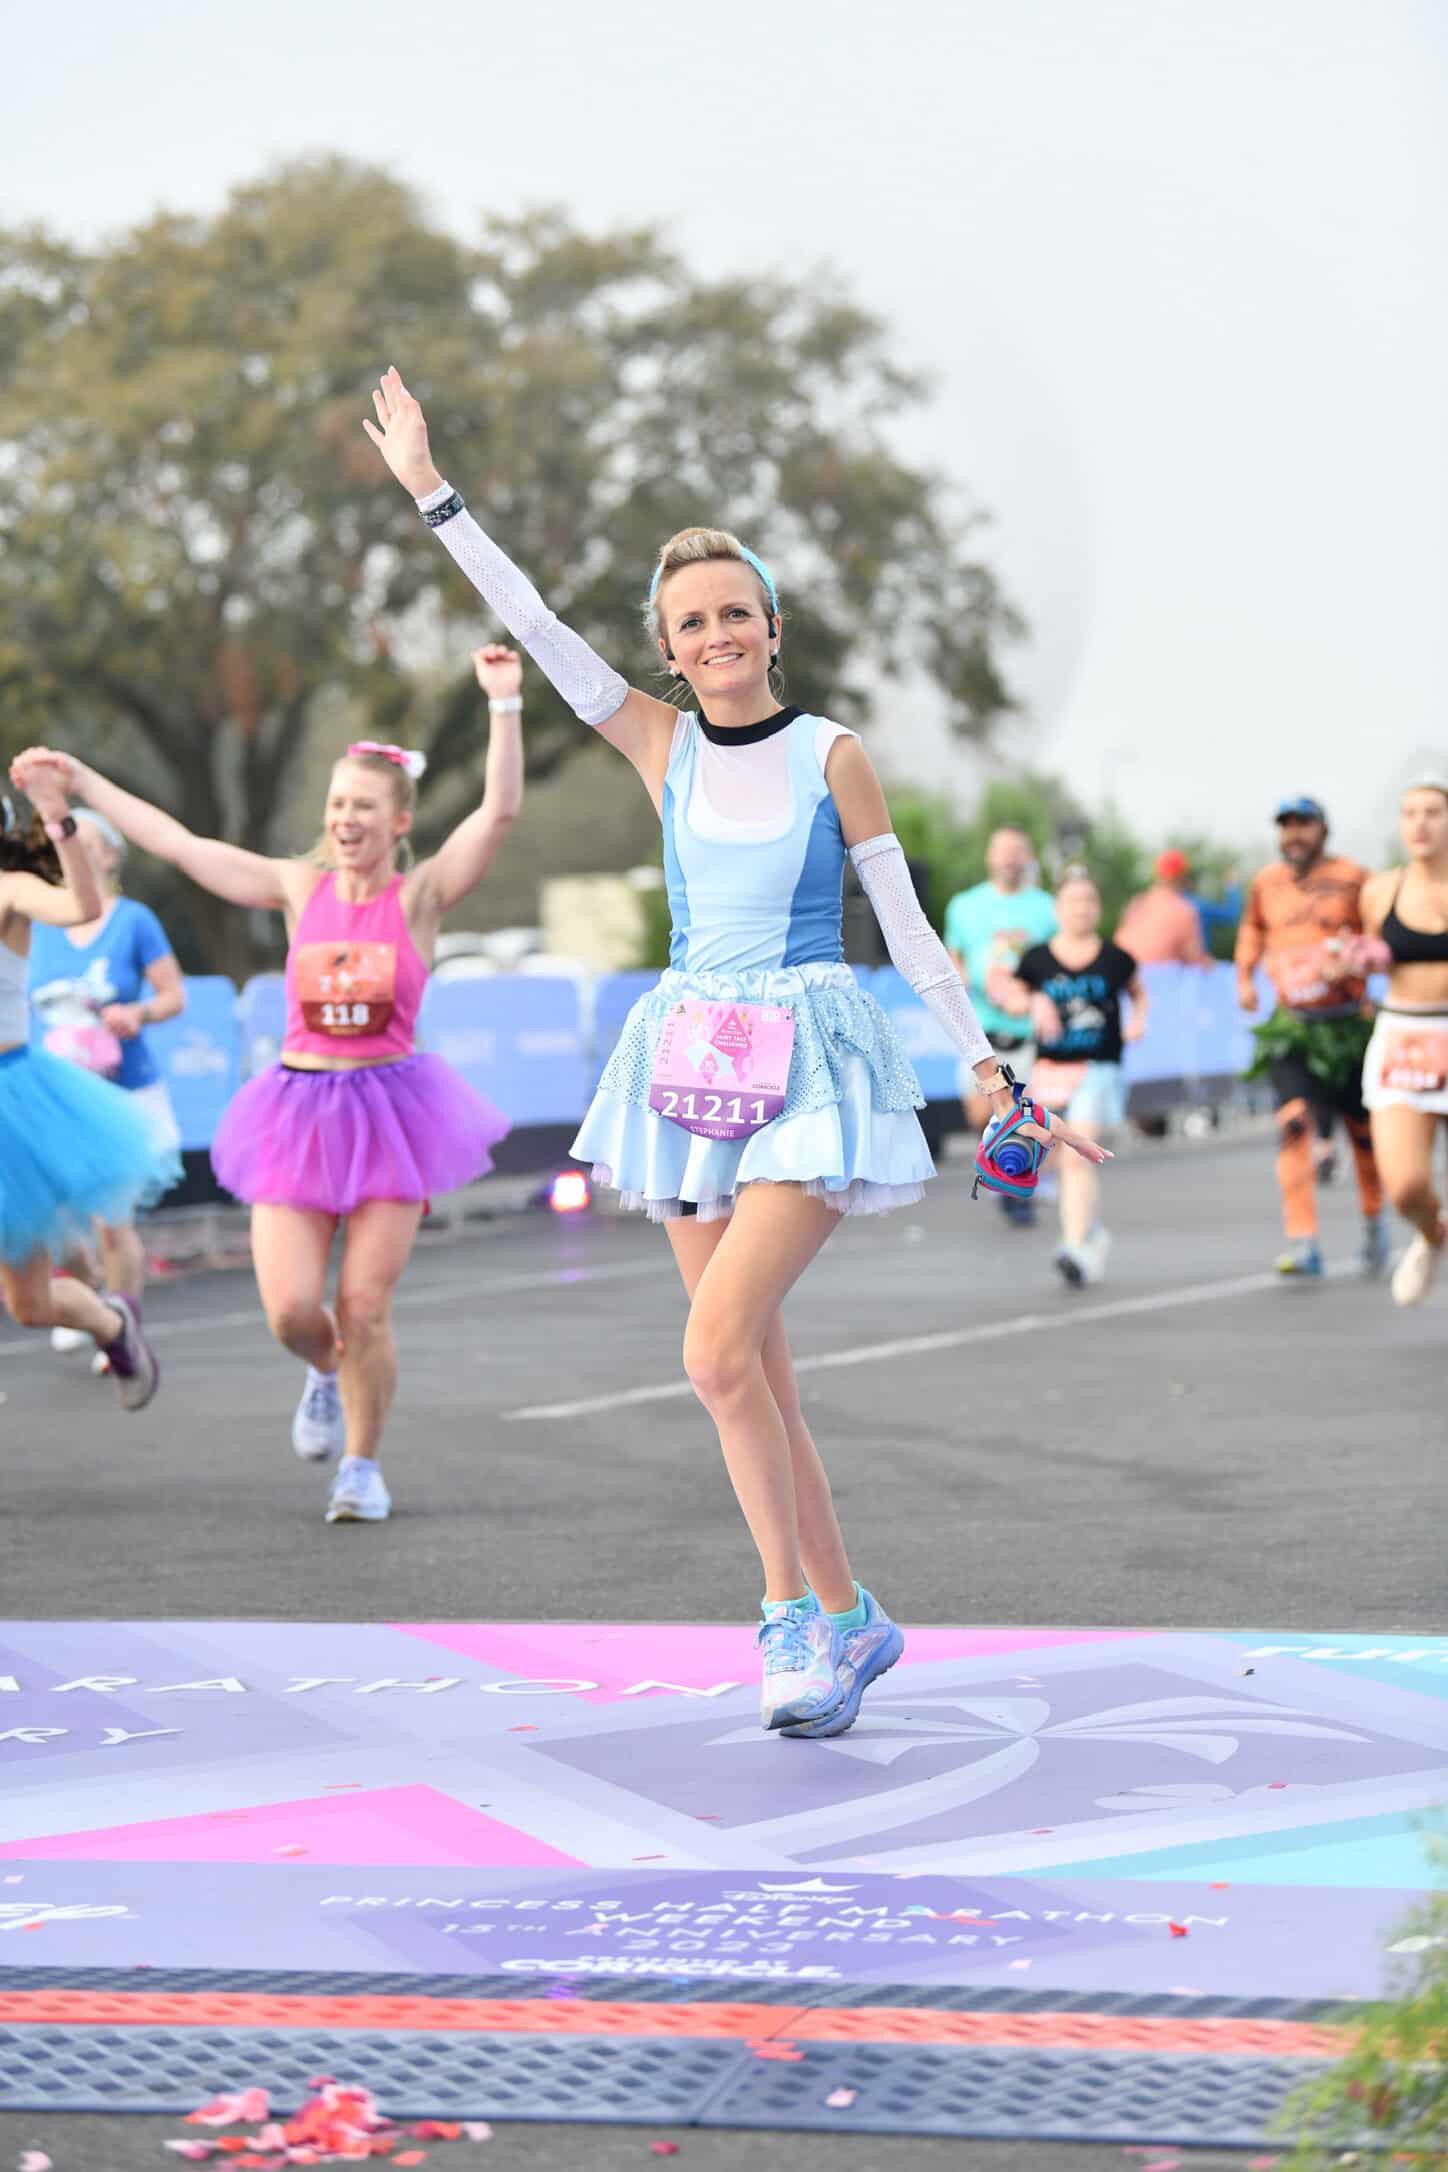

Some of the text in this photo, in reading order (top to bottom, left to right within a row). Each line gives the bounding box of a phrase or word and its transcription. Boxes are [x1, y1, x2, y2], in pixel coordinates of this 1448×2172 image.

[660, 1091, 769, 1124] 21211
[0, 1676, 743, 1698] RATHON
[319, 1896, 622, 1910] PRINCESS
[652, 1900, 811, 1917] HALF
[594, 1911, 912, 1929] WEEKEND
[563, 1924, 1024, 1945] ANNIVERSARY
[621, 1938, 795, 1952] 2023
